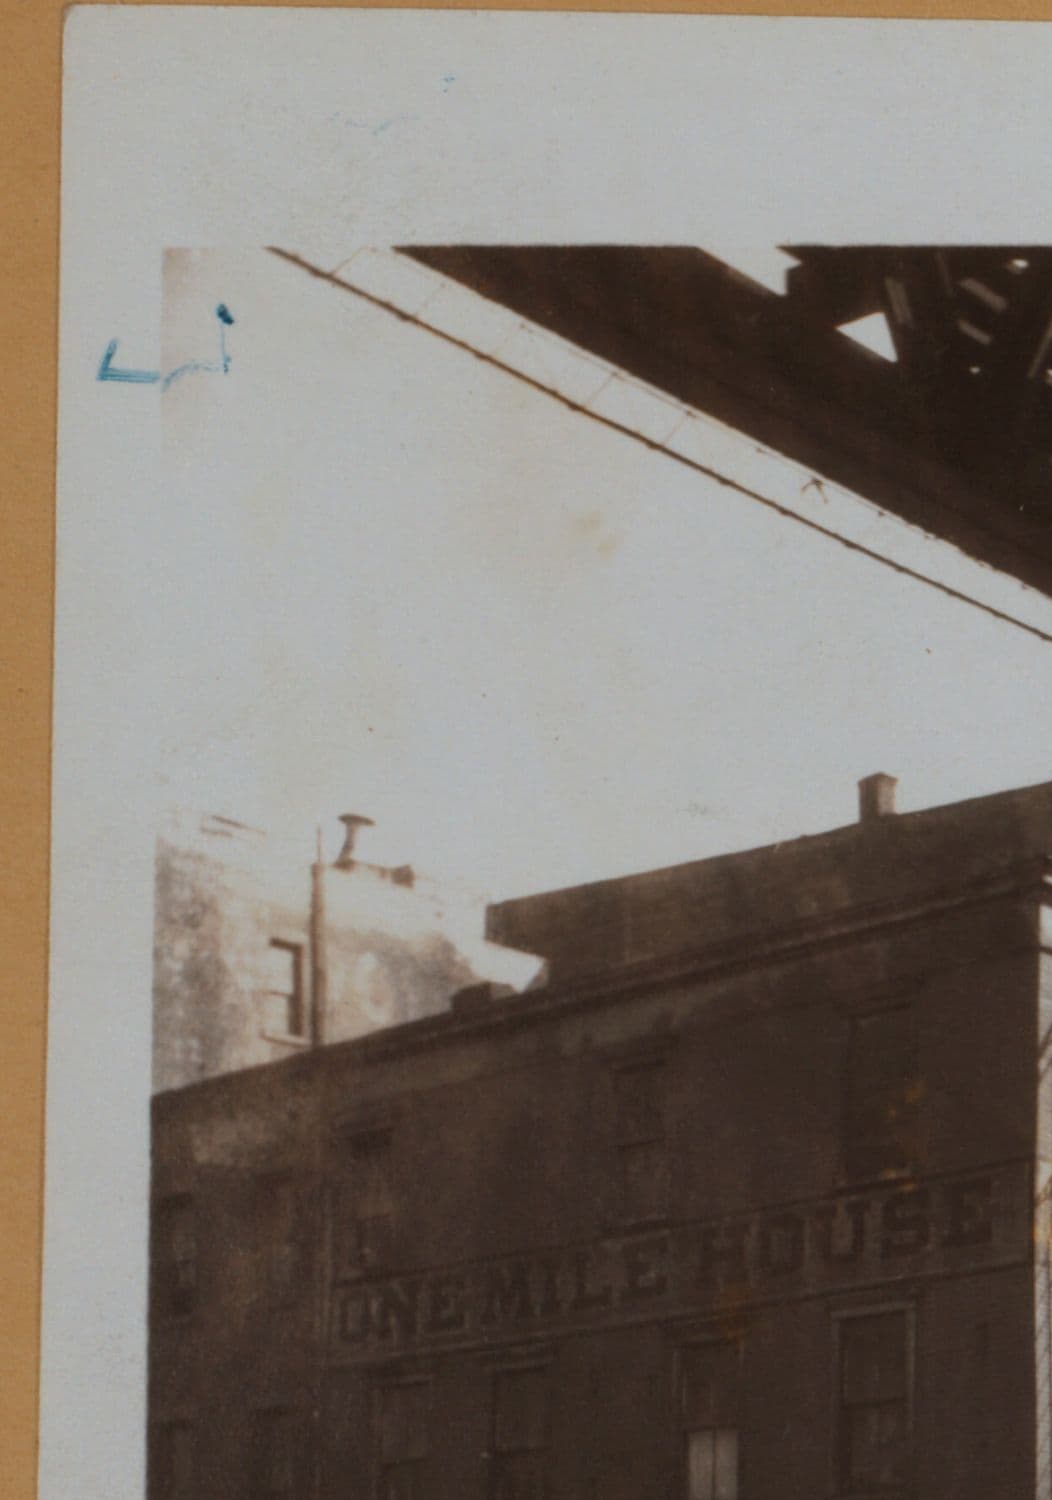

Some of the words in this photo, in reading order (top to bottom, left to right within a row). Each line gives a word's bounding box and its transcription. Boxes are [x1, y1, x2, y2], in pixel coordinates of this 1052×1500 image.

[341, 1276, 466, 1343] ONE
[481, 1240, 668, 1325] MILE
[694, 1178, 993, 1288] HOUSE
